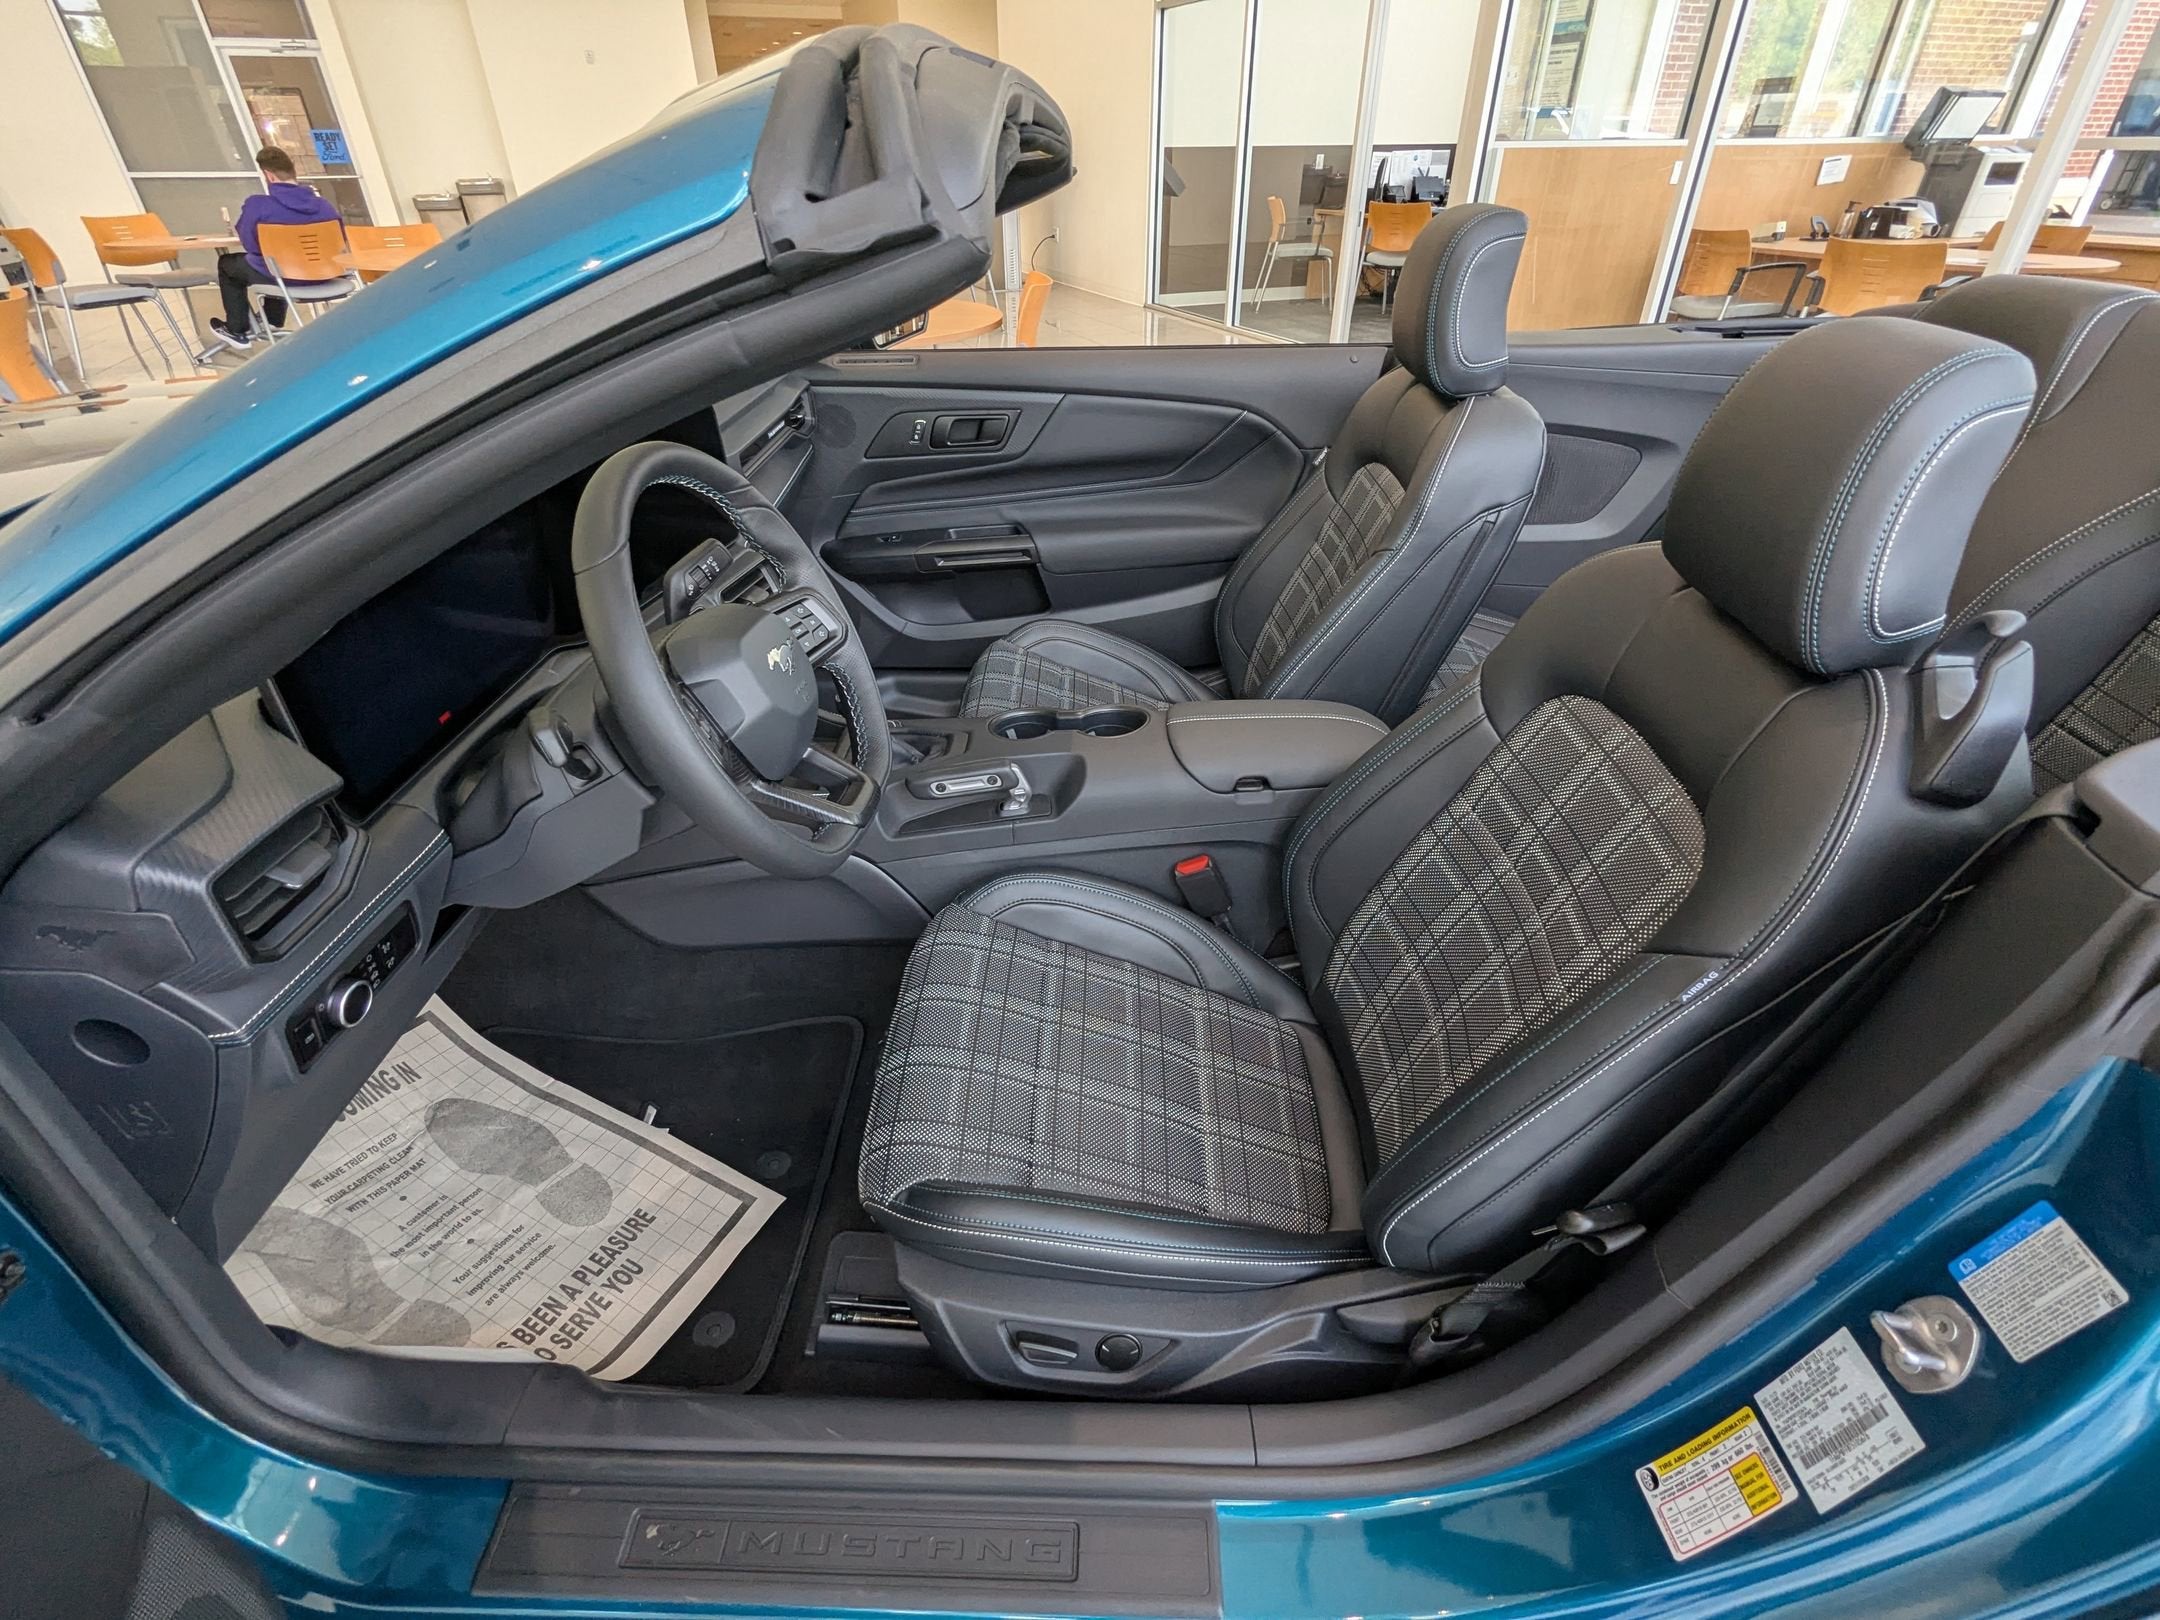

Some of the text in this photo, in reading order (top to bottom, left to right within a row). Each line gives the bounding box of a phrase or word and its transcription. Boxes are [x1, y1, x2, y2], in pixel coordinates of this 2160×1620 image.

[313, 132, 341, 141] READY
[321, 151, 346, 161] Ford
[322, 141, 337, 151] SET
[1681, 970, 1719, 1002] AIRBAG
[336, 1061, 422, 1122] MING IN
[309, 1132, 399, 1190] WE HAVE TRIED TO KEEP
[324, 1145, 415, 1205] YOUR CARPETING CLEAN
[345, 1158, 427, 1213] WITH THIS PAPER MAT
[389, 1187, 484, 1258] the most important person
[406, 1200, 440, 1227] customer
[419, 1208, 484, 1258] in the world to us.
[452, 1224, 525, 1284] Your suggestions for
[466, 1232, 542, 1296] improving our service
[485, 1244, 556, 1306] are always welcome.
[510, 1207, 657, 1346] BEEN A PLEASURE
[549, 1291, 613, 1350] SERVE
[601, 1257, 644, 1295] YOU
[1658, 1413, 1752, 1472] TIRE AND LOADING INFORMATION
[737, 1529, 1061, 1563] MUSTANG
